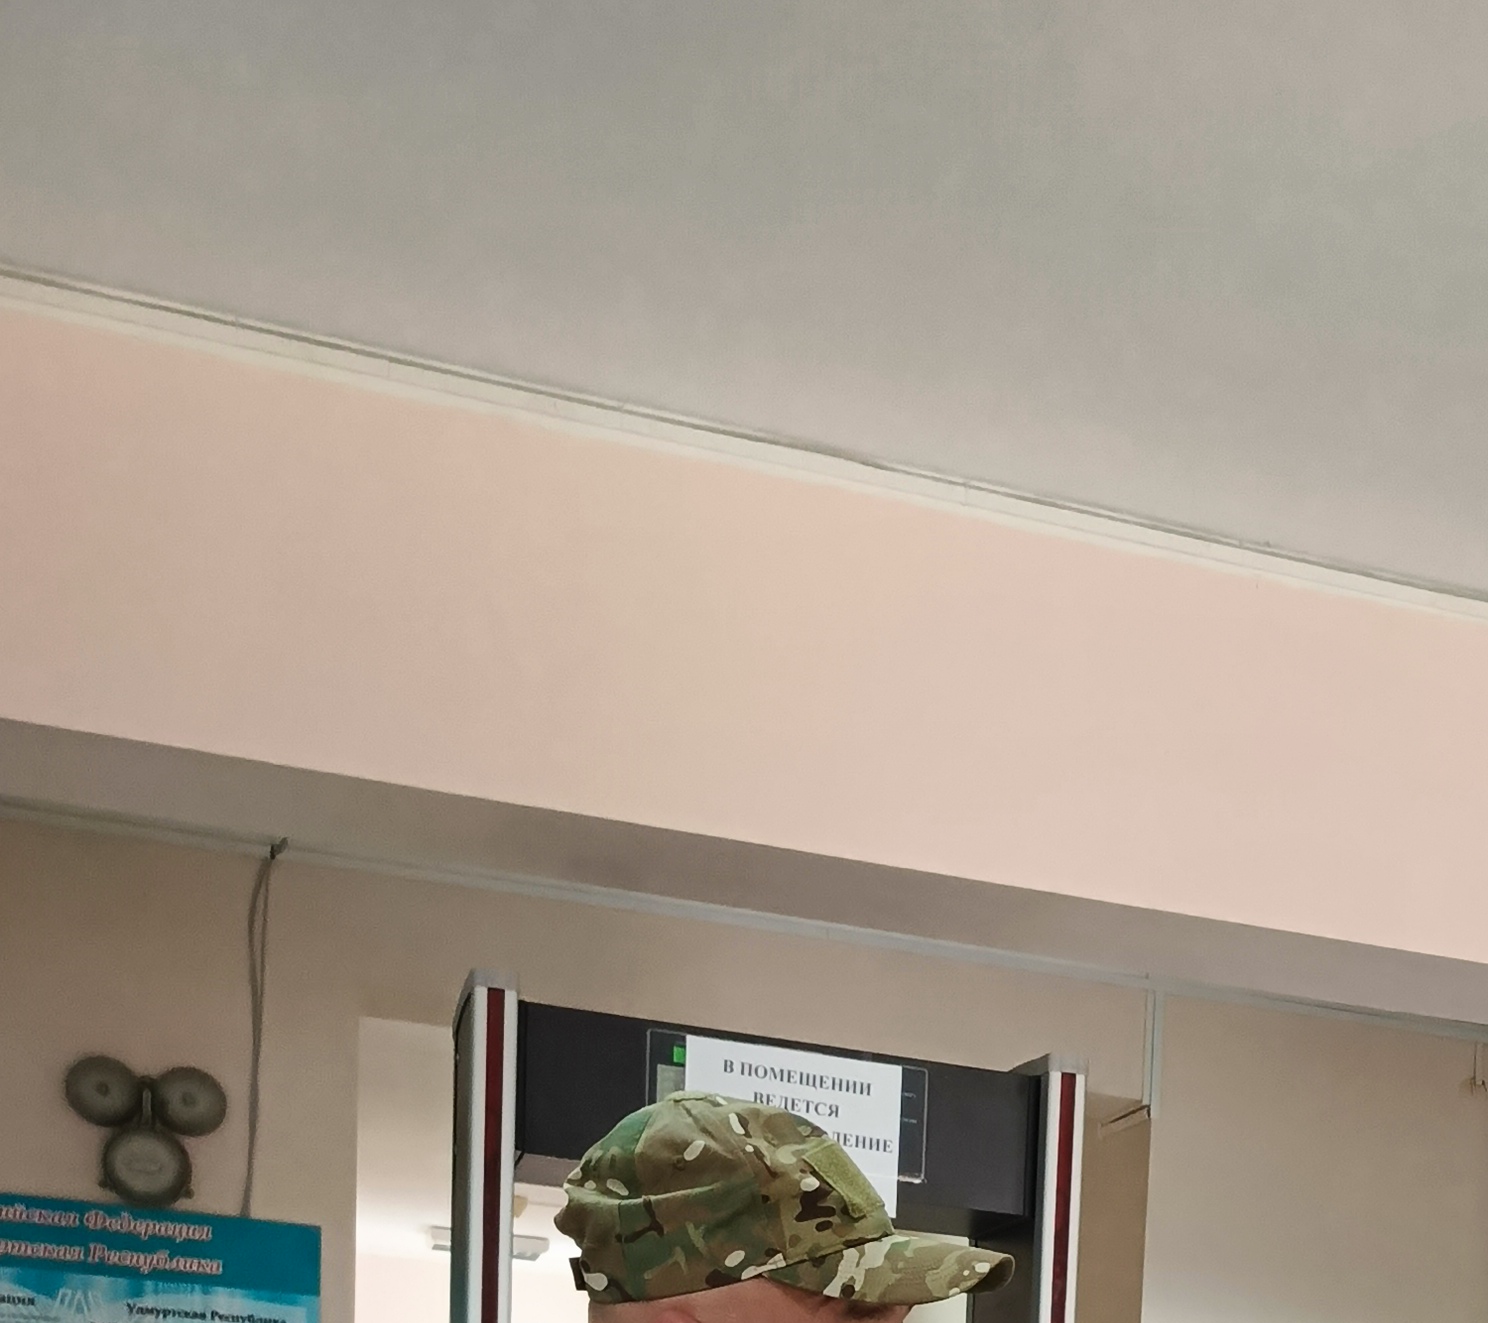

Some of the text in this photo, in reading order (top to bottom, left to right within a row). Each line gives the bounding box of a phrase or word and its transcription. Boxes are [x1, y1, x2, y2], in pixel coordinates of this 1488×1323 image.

[723, 1059, 872, 1096] В ПОМЕЩЕНИИ
[752, 1091, 840, 1119] ВЕДЕТСЯ
[830, 1131, 894, 1154] ДЕНИЕ
[88, 1243, 223, 1274] Республика
